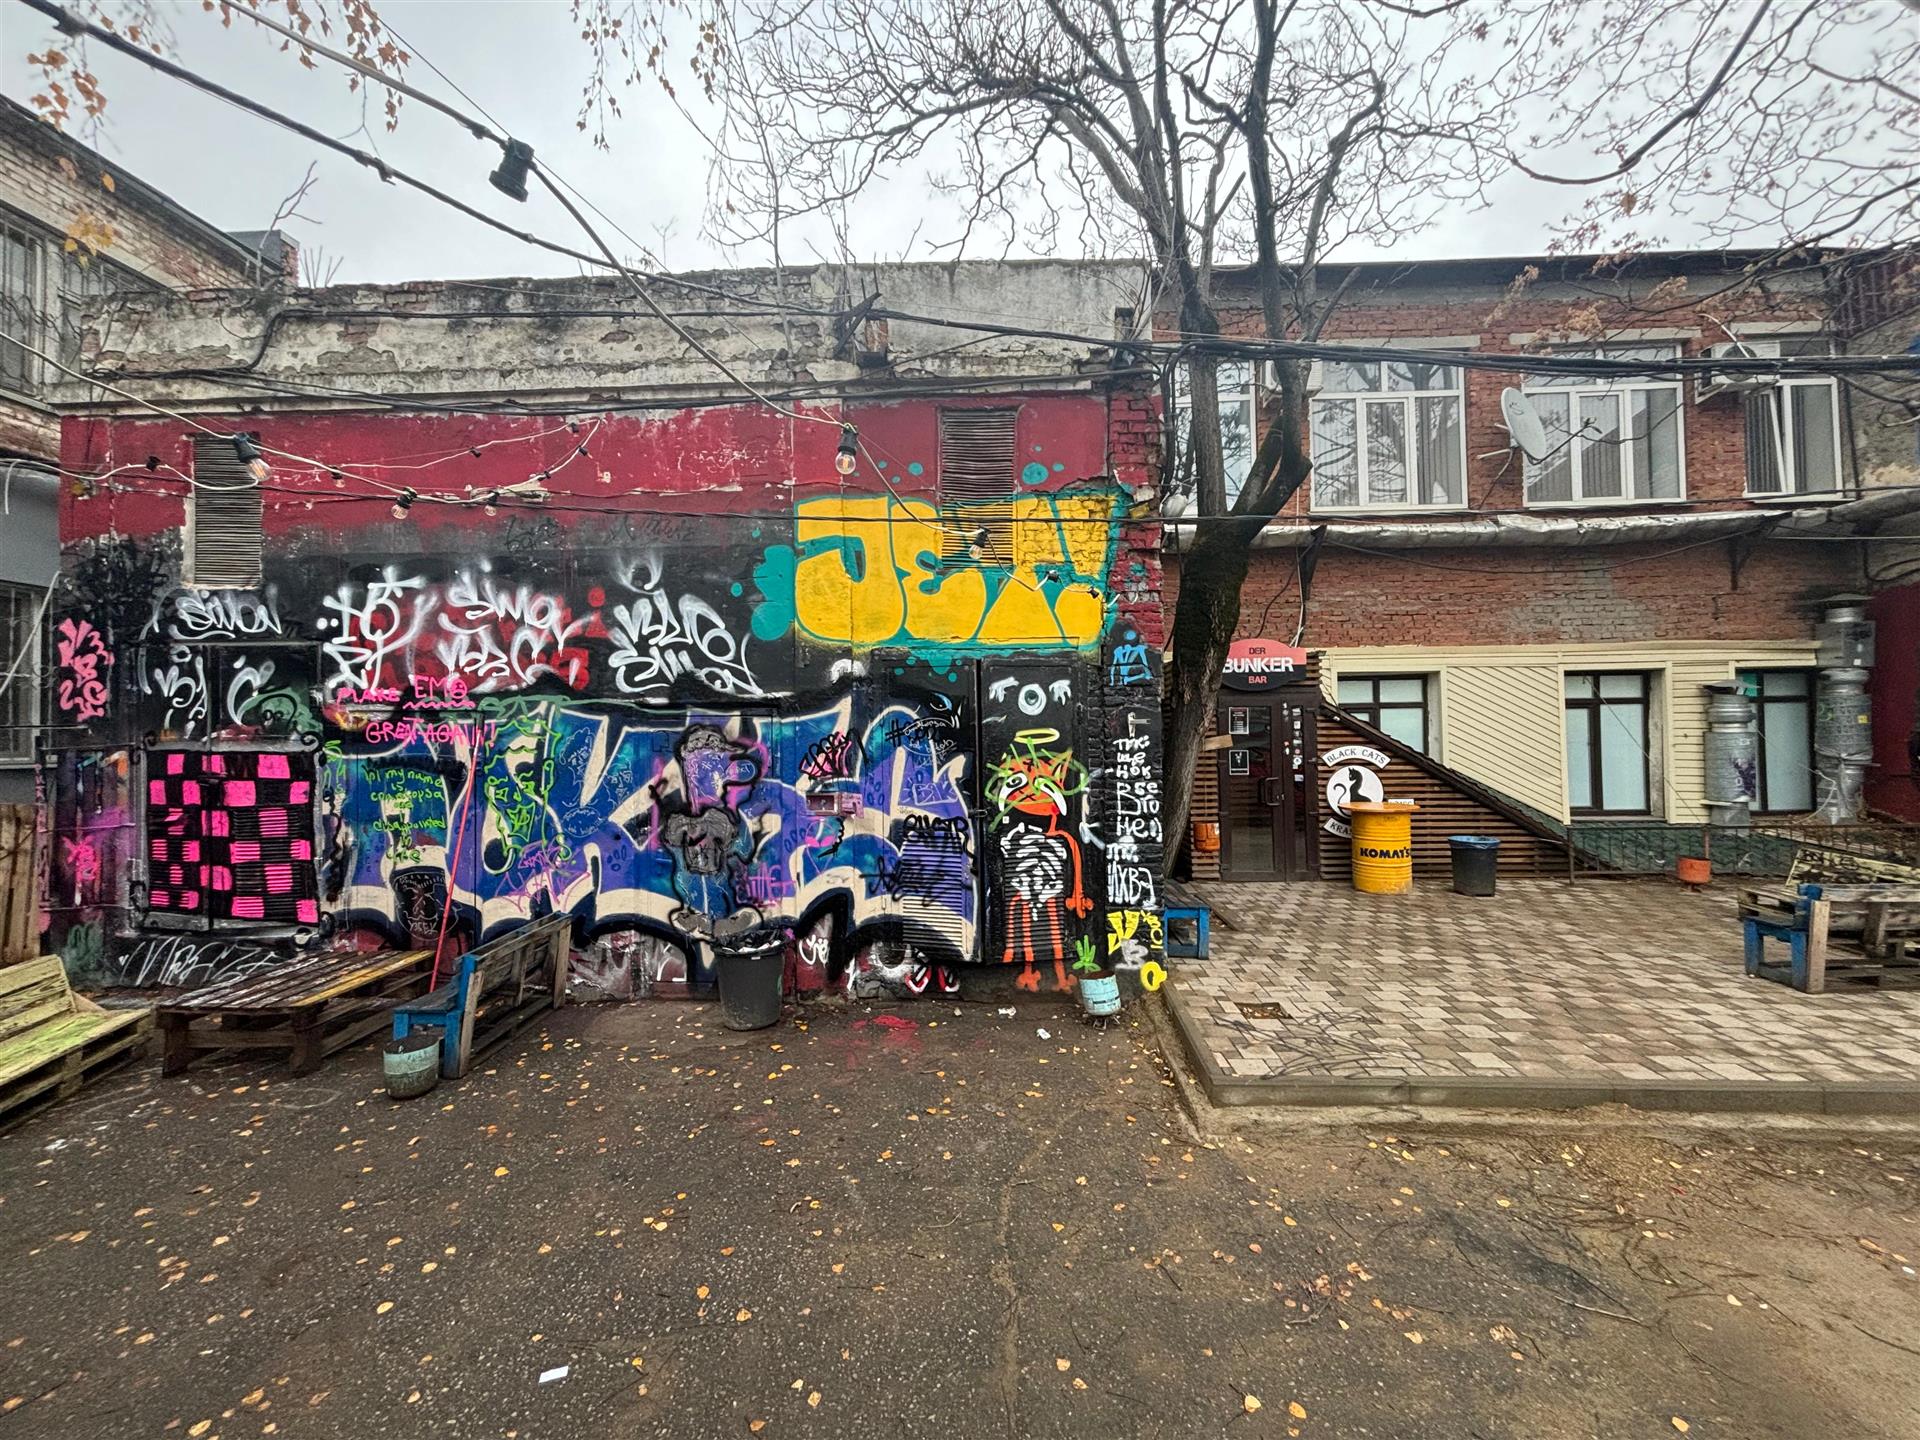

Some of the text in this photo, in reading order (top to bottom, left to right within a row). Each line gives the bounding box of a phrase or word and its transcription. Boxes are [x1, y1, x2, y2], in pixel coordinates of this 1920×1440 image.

[1249, 647, 1266, 655] DER
[1222, 656, 1294, 673] BUNKER
[1248, 675, 1267, 684] BAR
[1327, 748, 1386, 764] BLACK CATS
[1330, 821, 1351, 836] KRA
